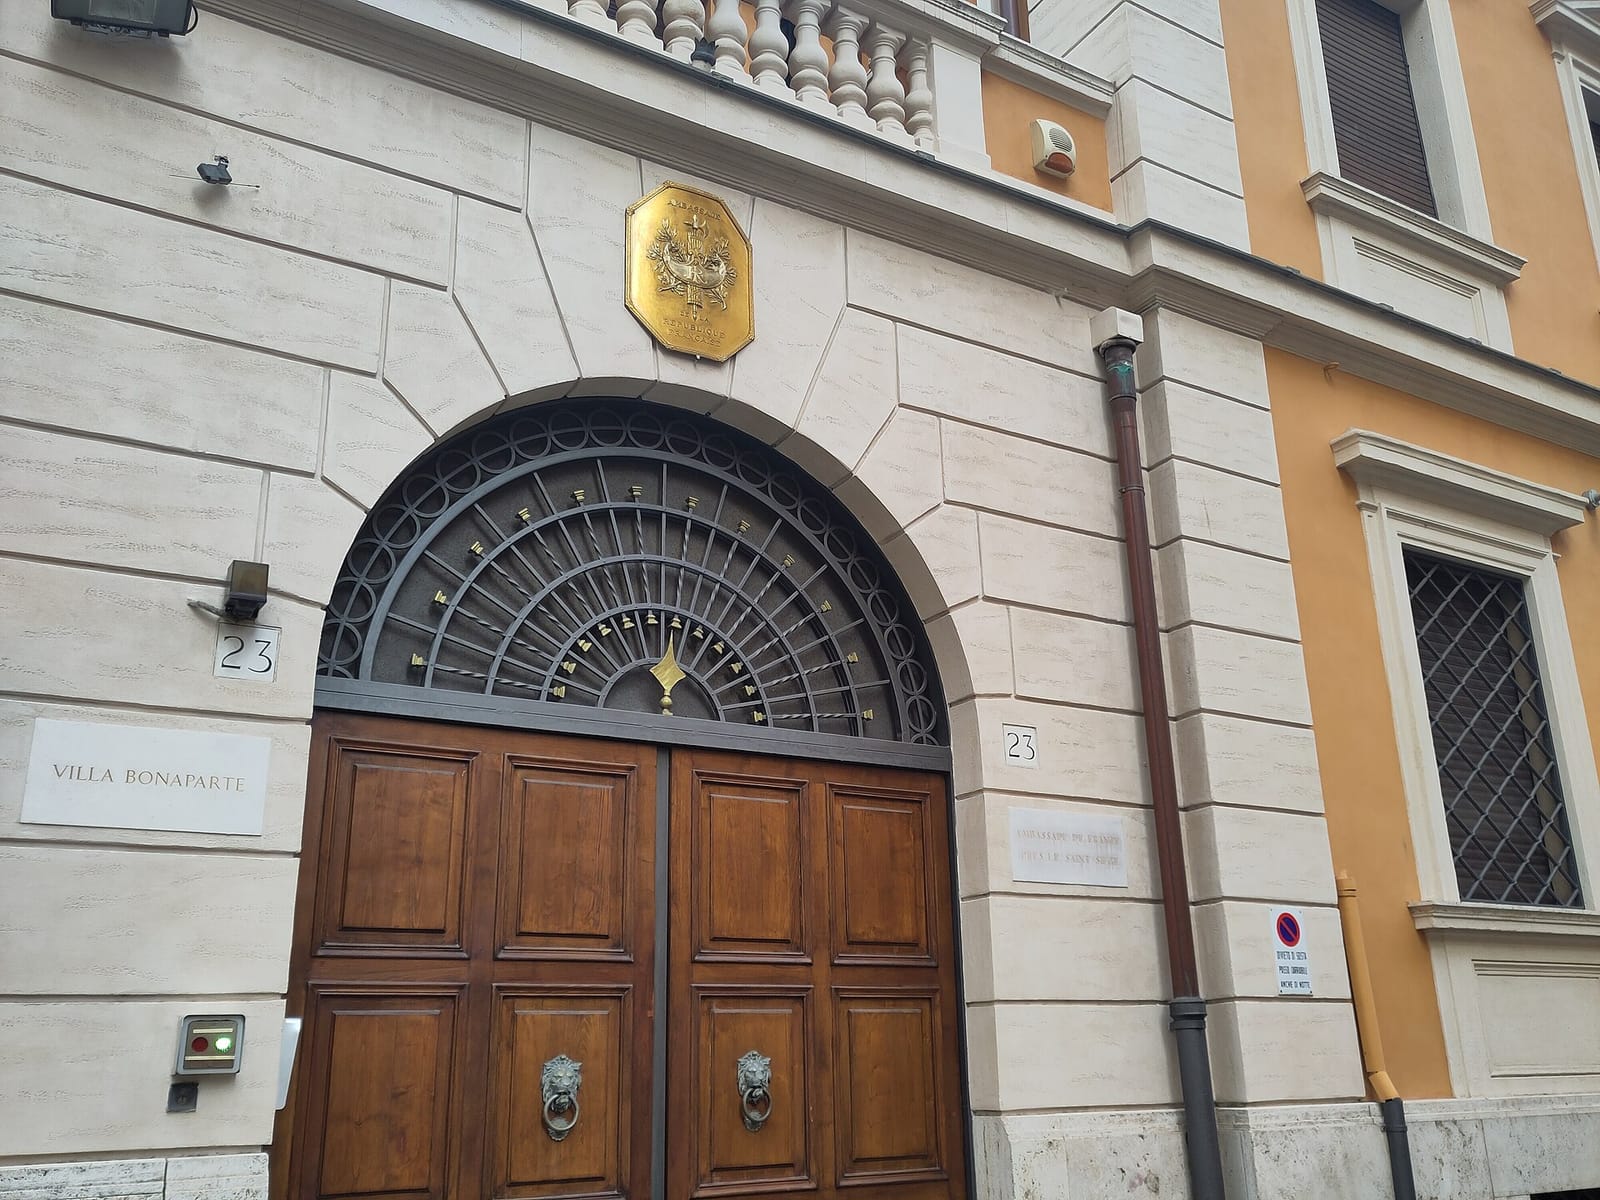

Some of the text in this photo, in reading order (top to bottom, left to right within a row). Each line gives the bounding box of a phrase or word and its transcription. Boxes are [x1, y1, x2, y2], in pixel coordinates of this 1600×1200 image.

[221, 635, 273, 674] 23
[1007, 732, 1035, 761] 23
[52, 764, 245, 793] VILLA BONAPARTE
